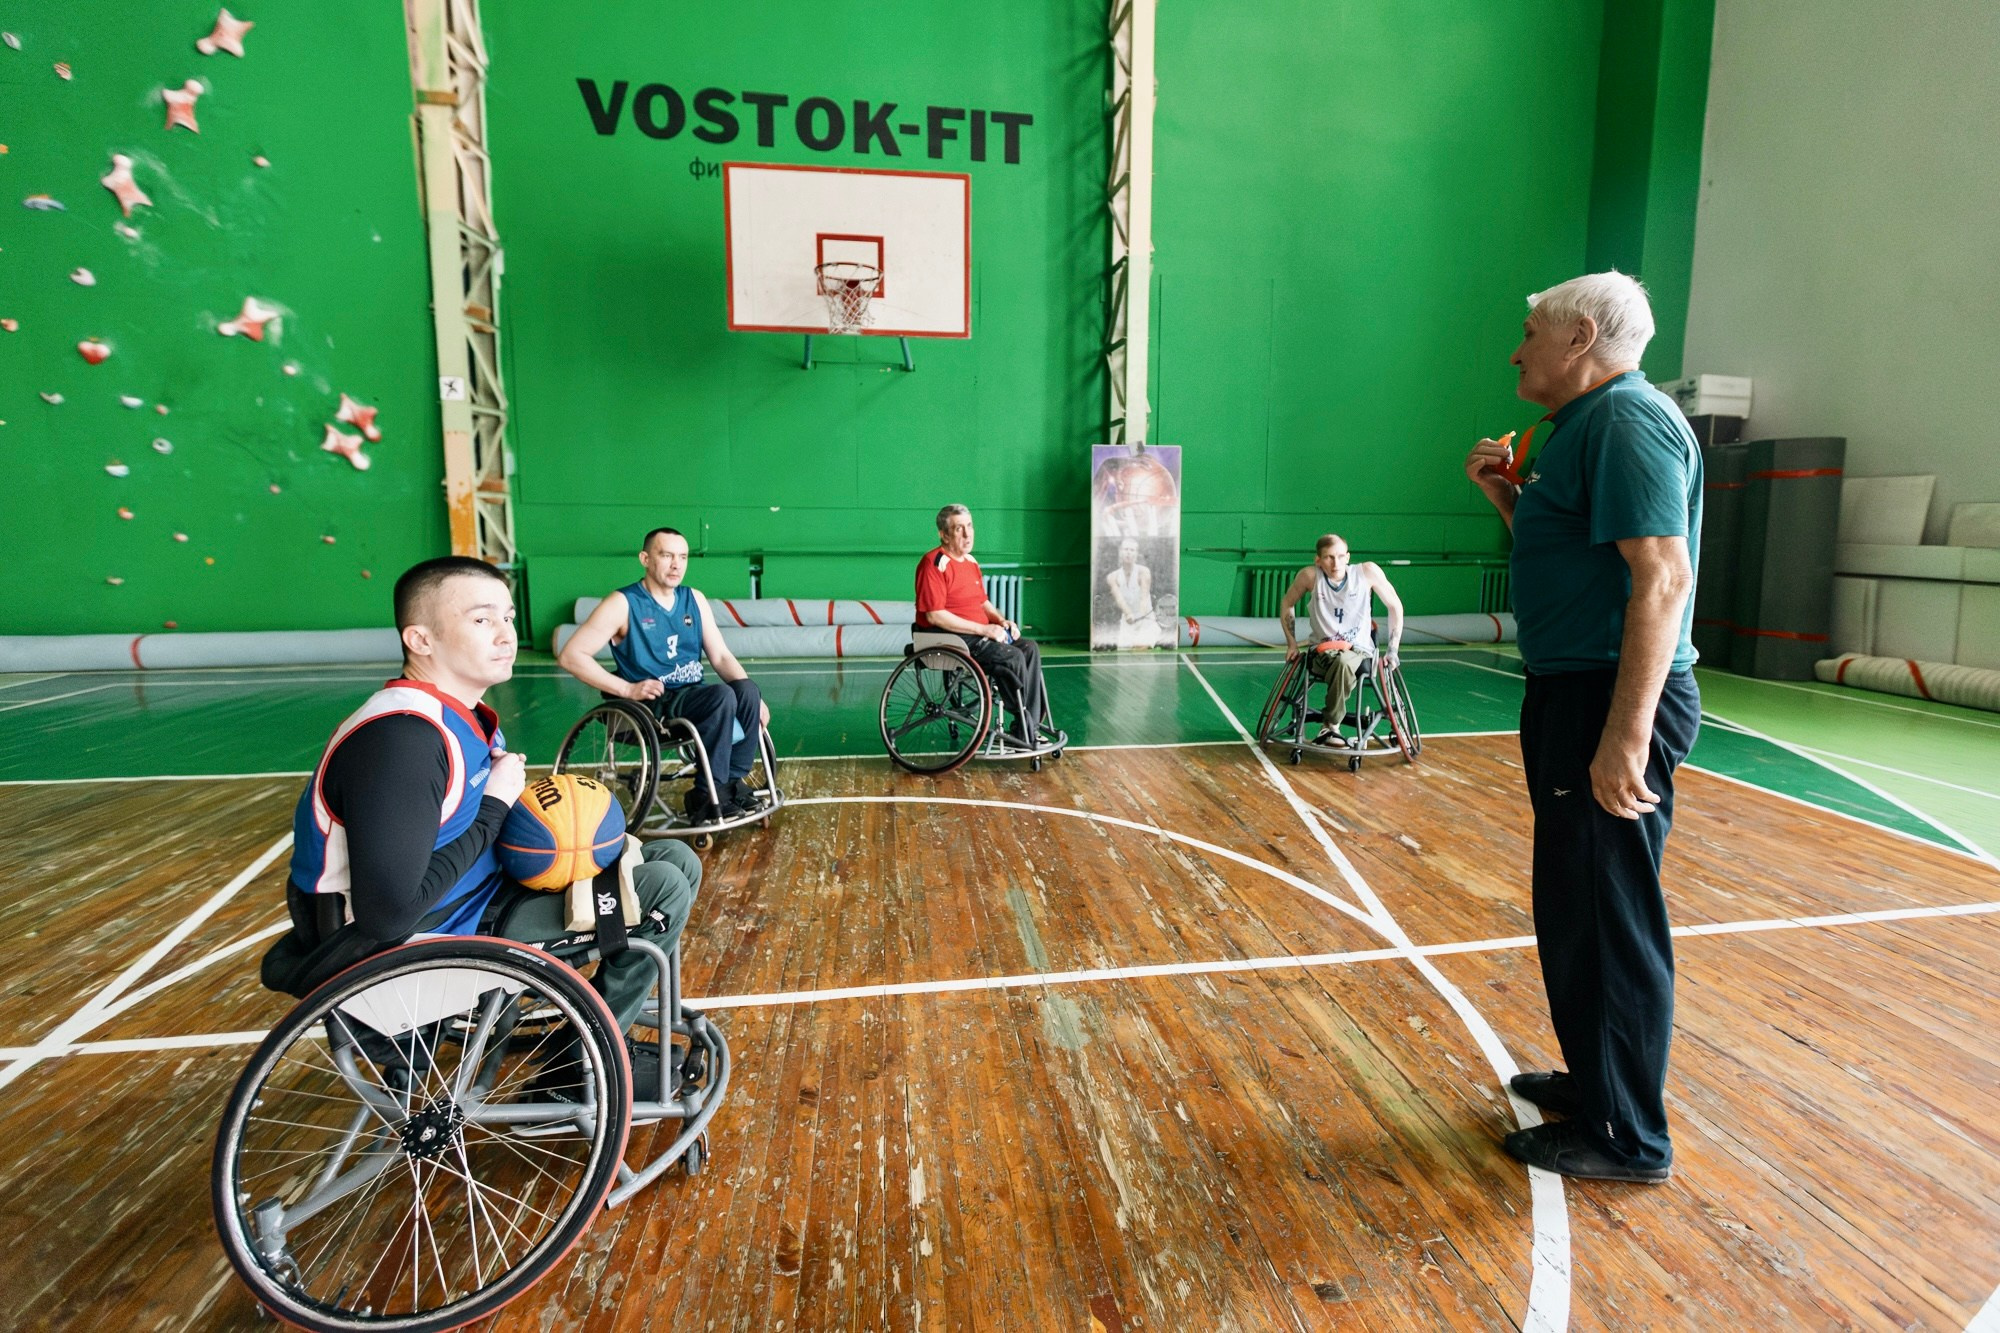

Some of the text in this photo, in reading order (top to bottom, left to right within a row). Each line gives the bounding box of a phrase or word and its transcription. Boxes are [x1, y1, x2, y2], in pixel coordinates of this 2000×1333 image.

[576, 78, 1033, 165] VOSTOK-FIT
[689, 156, 720, 181] фи
[1334, 608, 1344, 624] 4
[666, 634, 679, 659] 3
